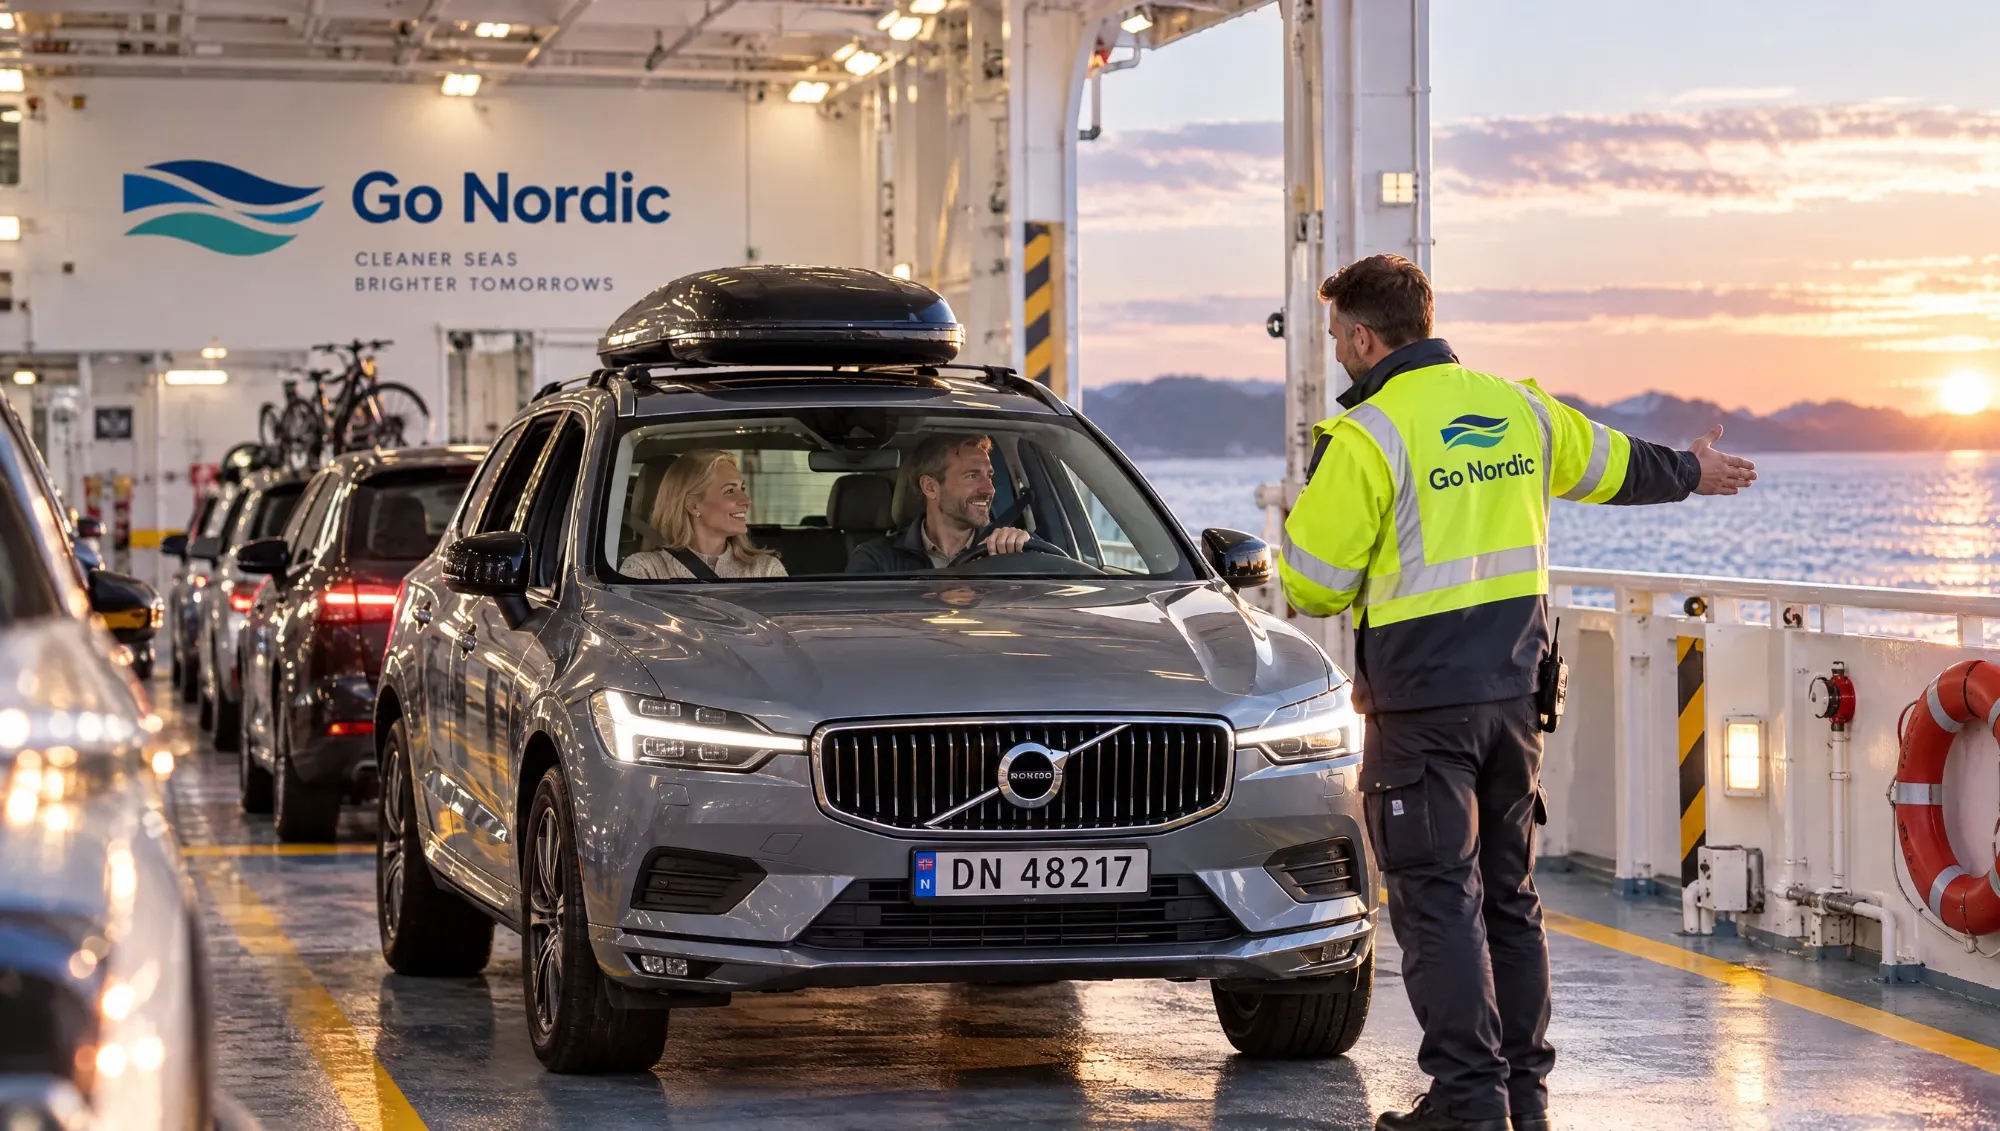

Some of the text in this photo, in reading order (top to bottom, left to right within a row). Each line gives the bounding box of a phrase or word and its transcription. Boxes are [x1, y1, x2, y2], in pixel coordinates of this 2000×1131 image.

[351, 170, 671, 224] Go Nordic
[354, 251, 518, 267] CLEANER SEAS
[354, 276, 614, 292] BRIGHTER TOMORROWS
[1429, 453, 1535, 490] Go Nordic
[920, 879, 931, 890] N
[952, 855, 1132, 890] DN 48217
